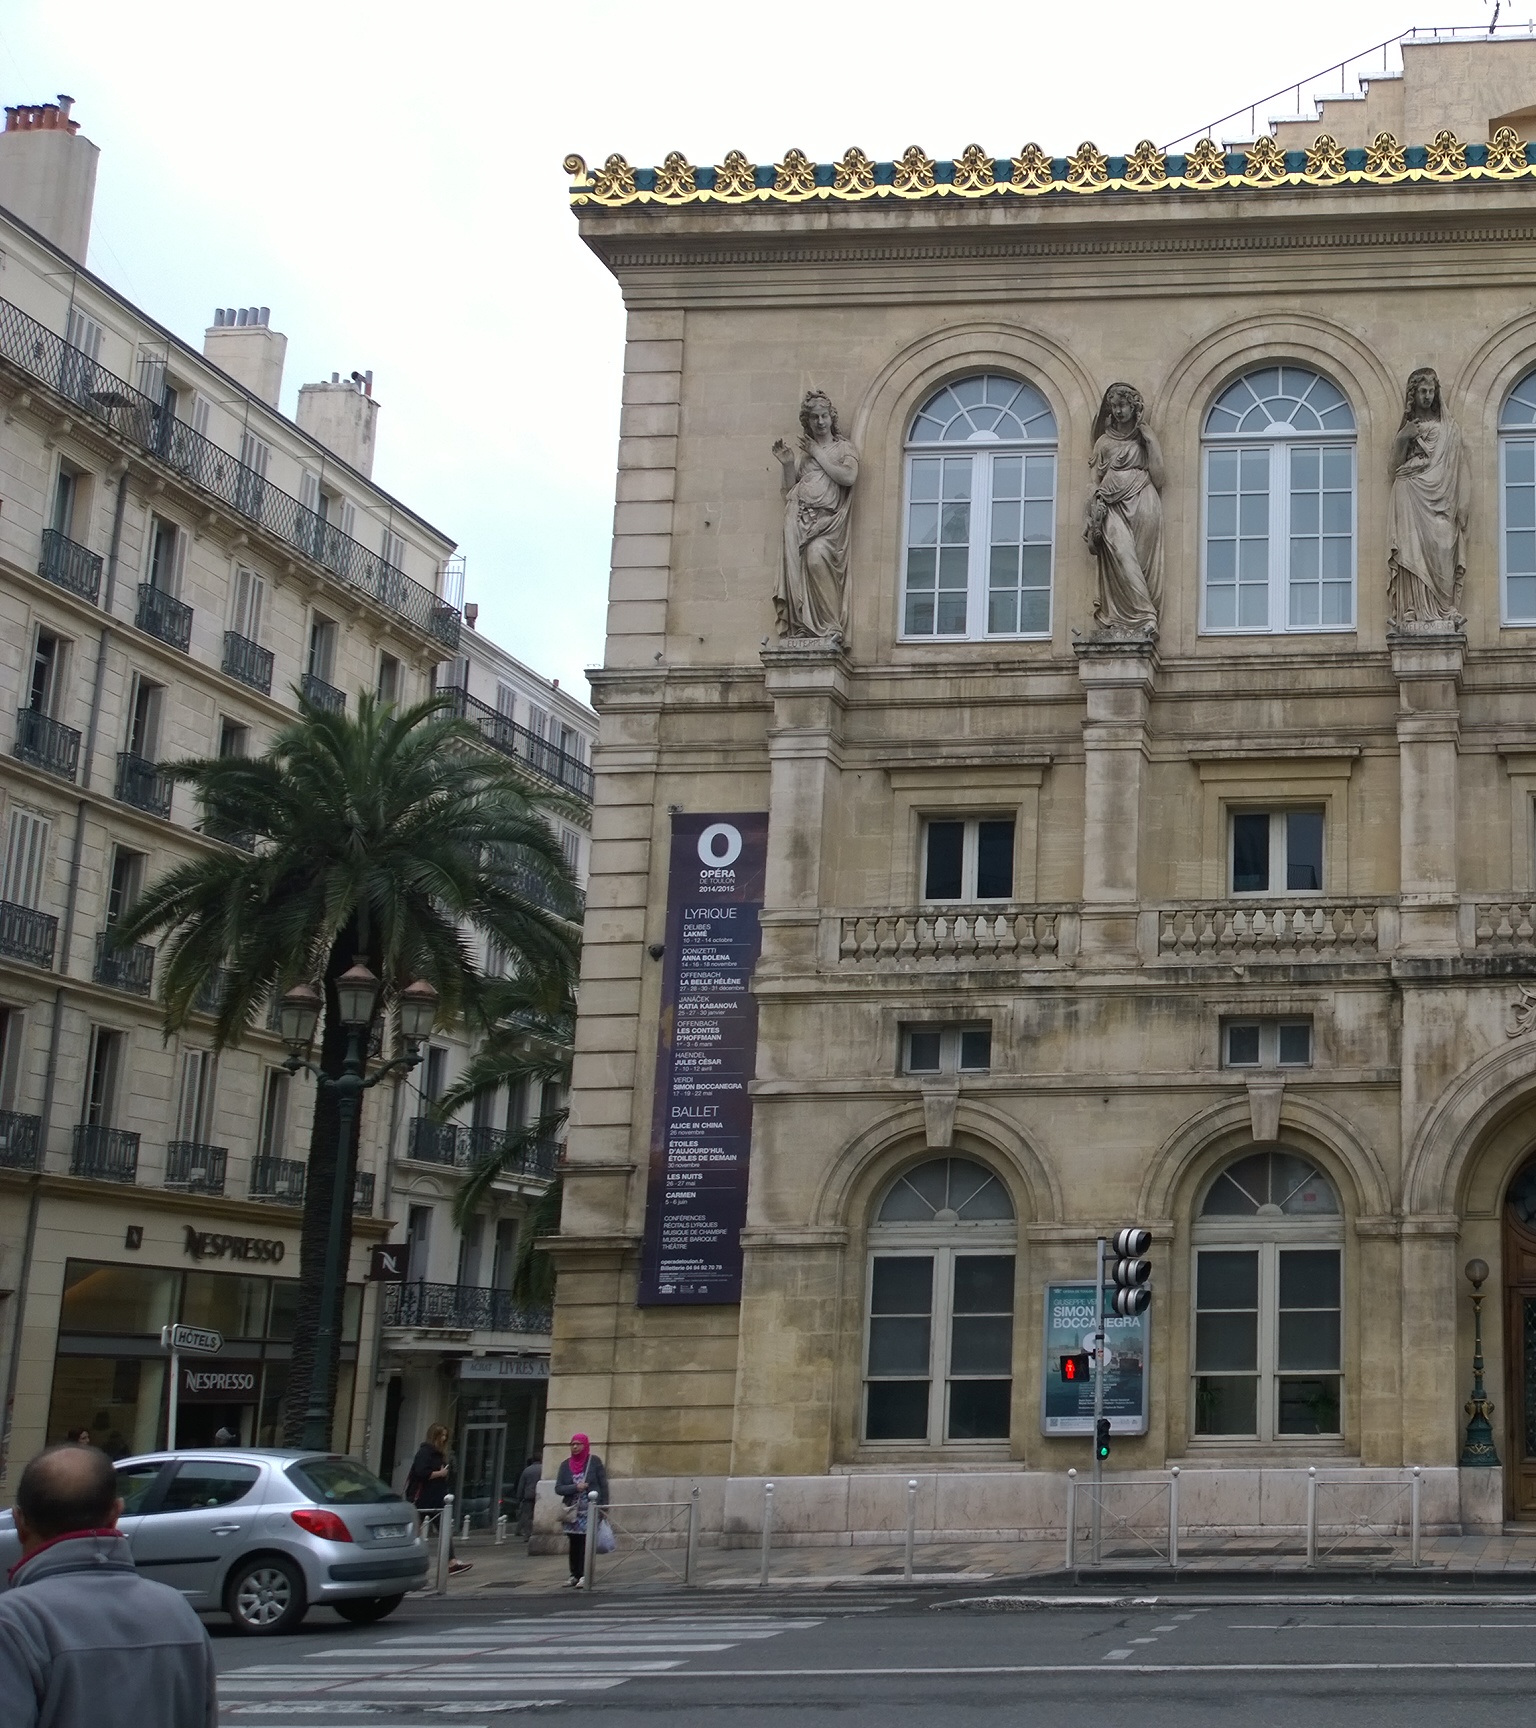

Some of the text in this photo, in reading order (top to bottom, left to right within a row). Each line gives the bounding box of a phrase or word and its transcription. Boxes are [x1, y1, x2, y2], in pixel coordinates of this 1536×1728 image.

[697, 823, 742, 868] O
[700, 868, 735, 878] OPÉRA
[685, 908, 737, 919] LYRIQUE
[671, 1106, 719, 1117] BALLET
[183, 1224, 285, 1262] NESPRESSO
[1053, 1306, 1094, 1317] SIMON
[1053, 1317, 1140, 1328] BOCCAEGRA
[499, 1361, 534, 1375] LIVRES
[184, 1369, 254, 1392] NESPRESSO
